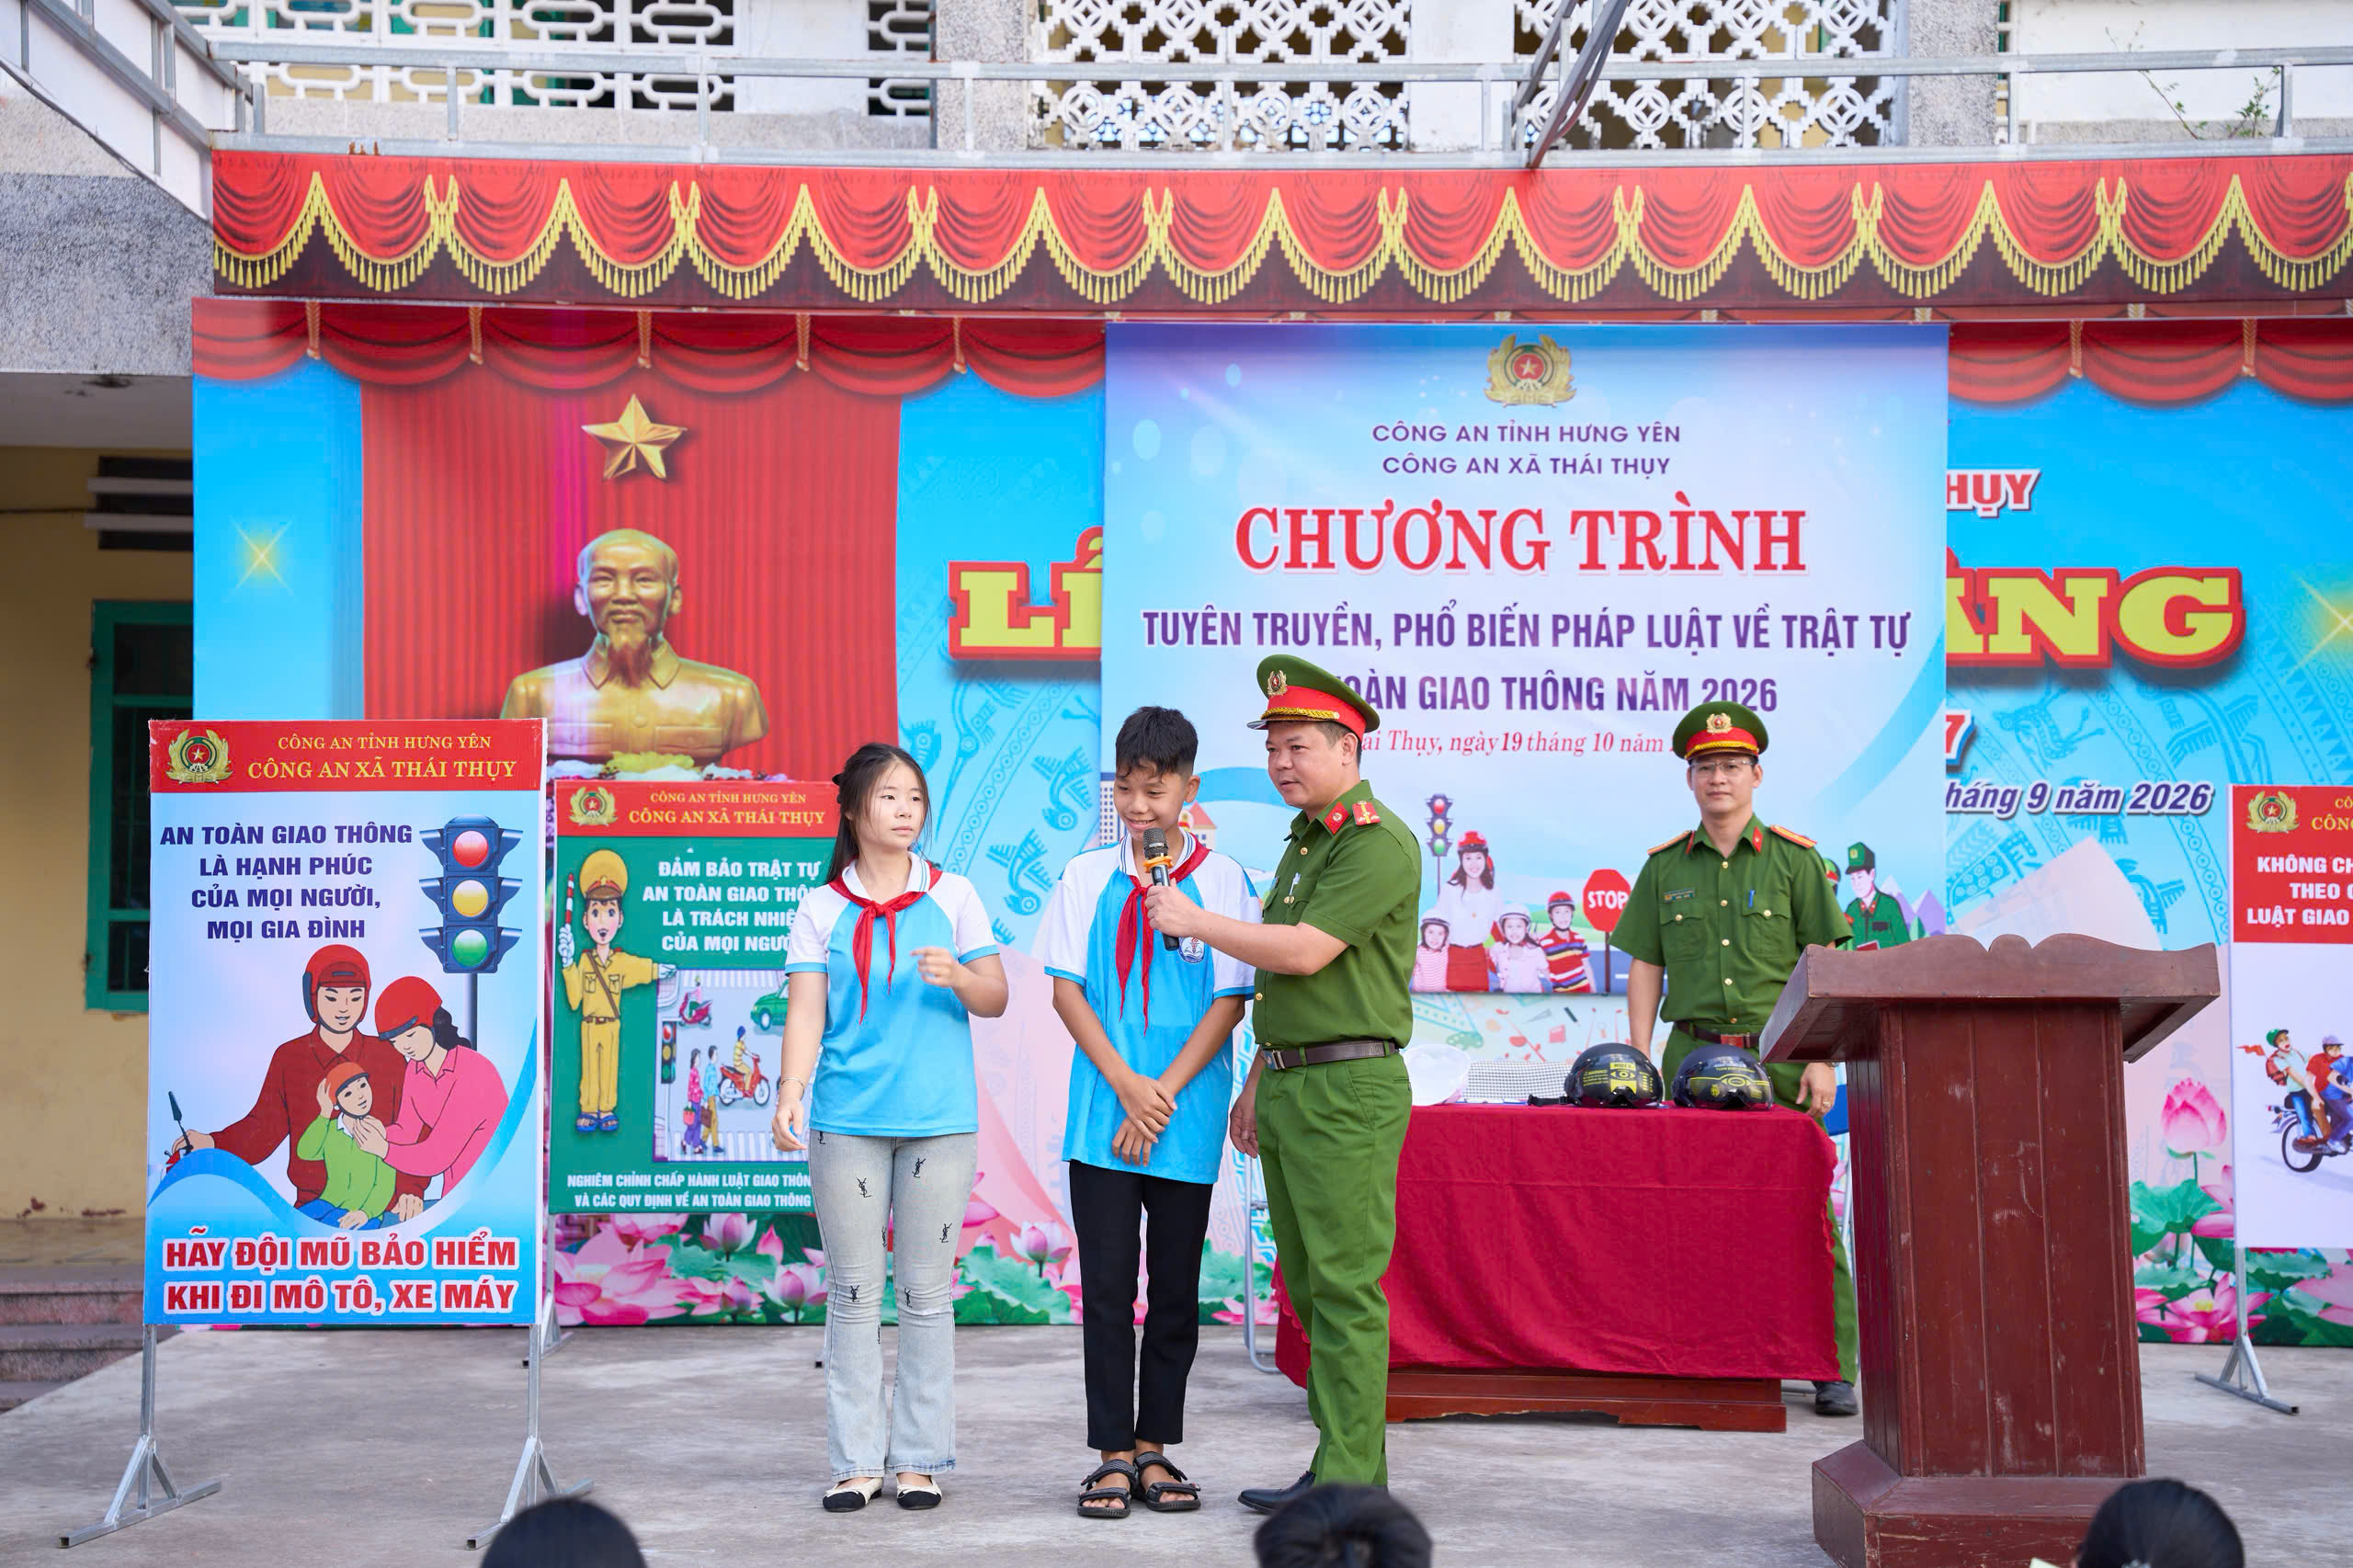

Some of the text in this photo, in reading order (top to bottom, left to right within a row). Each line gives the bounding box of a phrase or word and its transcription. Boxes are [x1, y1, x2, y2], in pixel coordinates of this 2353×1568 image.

[1372, 420, 1680, 443] CÔNG AN TỈNH HƯNG YÊN
[1382, 451, 1670, 480] CÔNG AN XÃ THÁI THỤY
[1946, 472, 2033, 512] HỤY
[1235, 490, 1806, 572] CHƯƠNG TRÌNH
[1142, 598, 1912, 657] TUYÊN TRUYỀN, PHỔ BIẾN PHÁP LUẬT VỀ TRẬT TỰ
[1336, 668, 1778, 712] OÀN GIAO THÔNG NĂM 2026
[278, 732, 492, 750] CÔNG AN TỈNH HƯNG YÊN
[1387, 730, 1443, 757] Thụy,
[1449, 731, 1499, 757] ngày
[1500, 733, 1523, 752] 19
[1527, 731, 1587, 757] tháng
[1593, 732, 1615, 752] 10
[1620, 733, 1664, 753] năm
[248, 756, 517, 782] CÔNG AN XÃ THÁI THỤY
[650, 790, 806, 803] CÔNG AN TỈNH HƯNG YÊN
[1946, 781, 2212, 815] háng 9 năm 2026
[2335, 796, 2353, 809] CÔ
[629, 807, 825, 827] CÔNG AN XÃ THÁI THỤY
[159, 821, 412, 846] AN TOÀN GIAO THÔNG
[199, 853, 372, 880] LÀ HẠNH PHÚC
[658, 857, 822, 881] ĐẢM BẢO TRẬT TỰ
[2256, 854, 2327, 873] KHÔNG
[191, 883, 381, 911] CỦA MỌI NGƯỜI,
[642, 883, 814, 902] AN TOÀN GIAO THÔ
[1587, 890, 1629, 909] STOP
[2289, 882, 2341, 900] THEO
[662, 908, 685, 926] LÀ
[689, 908, 748, 926] TRÁCH
[2246, 904, 2350, 928] LUẬT GIAO
[207, 915, 365, 943] MỌI GIA ĐÌNH
[661, 931, 699, 951] CỦA
[704, 936, 739, 954] MỌI
[567, 1171, 813, 1189] NGHIÊM CHỈNH CHẤP HÀNH LUẬT GIAO THÔN
[574, 1192, 590, 1207] VÀ
[593, 1193, 616, 1207] CÁC
[619, 1194, 642, 1208] QUY
[644, 1194, 672, 1210] ĐỊNH
[692, 1194, 709, 1207] AN
[711, 1193, 742, 1207] TOÀN
[745, 1194, 771, 1207] GIAO
[773, 1192, 811, 1207] THÔNG
[166, 1226, 517, 1273] HÃY ĐỘI MŨ BẢO HIỂM
[167, 1278, 515, 1312] KHI ĐI MÔ TÔ, XE MÁY
